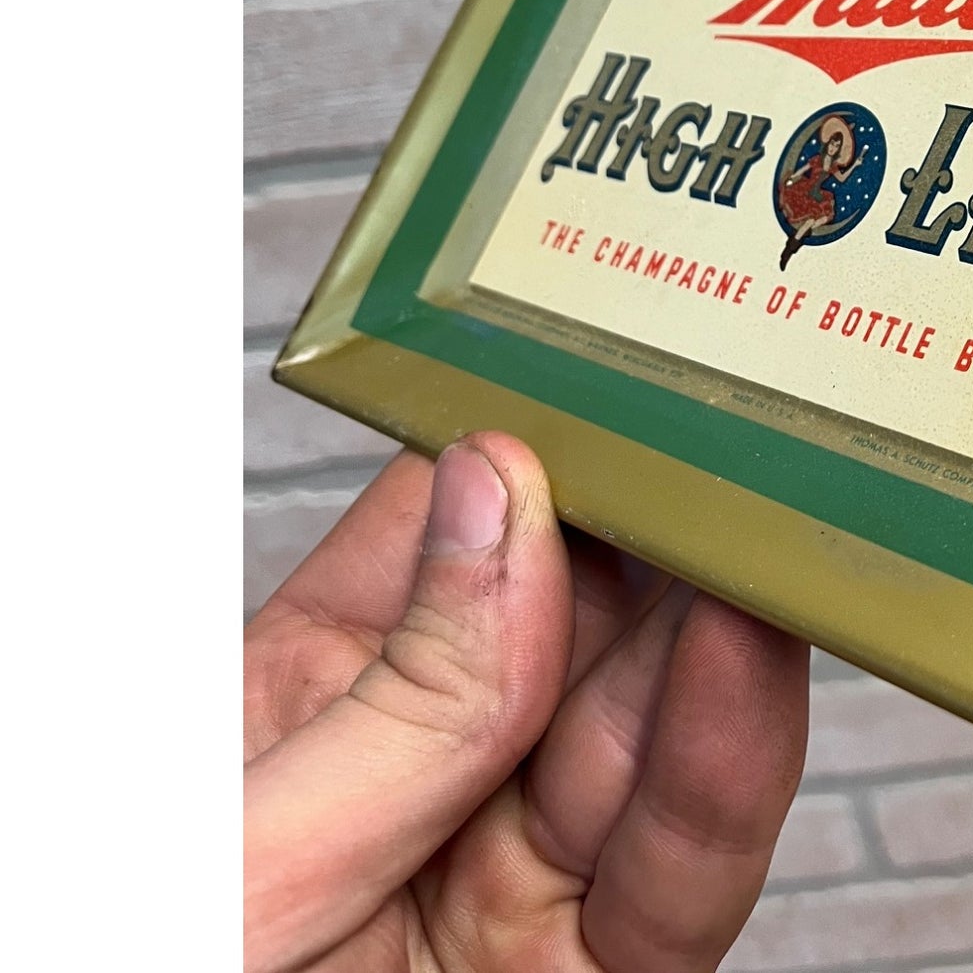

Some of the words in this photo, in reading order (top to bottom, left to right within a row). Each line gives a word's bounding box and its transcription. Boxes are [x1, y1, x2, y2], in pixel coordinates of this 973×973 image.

[541, 220, 583, 256] THE
[593, 238, 753, 305] CHAMPAGNE
[765, 286, 807, 320] OF
[818, 300, 936, 360] BOTTLE
[851, 435, 888, 455] THOMAS
[903, 454, 940, 474] SCHUTZ
